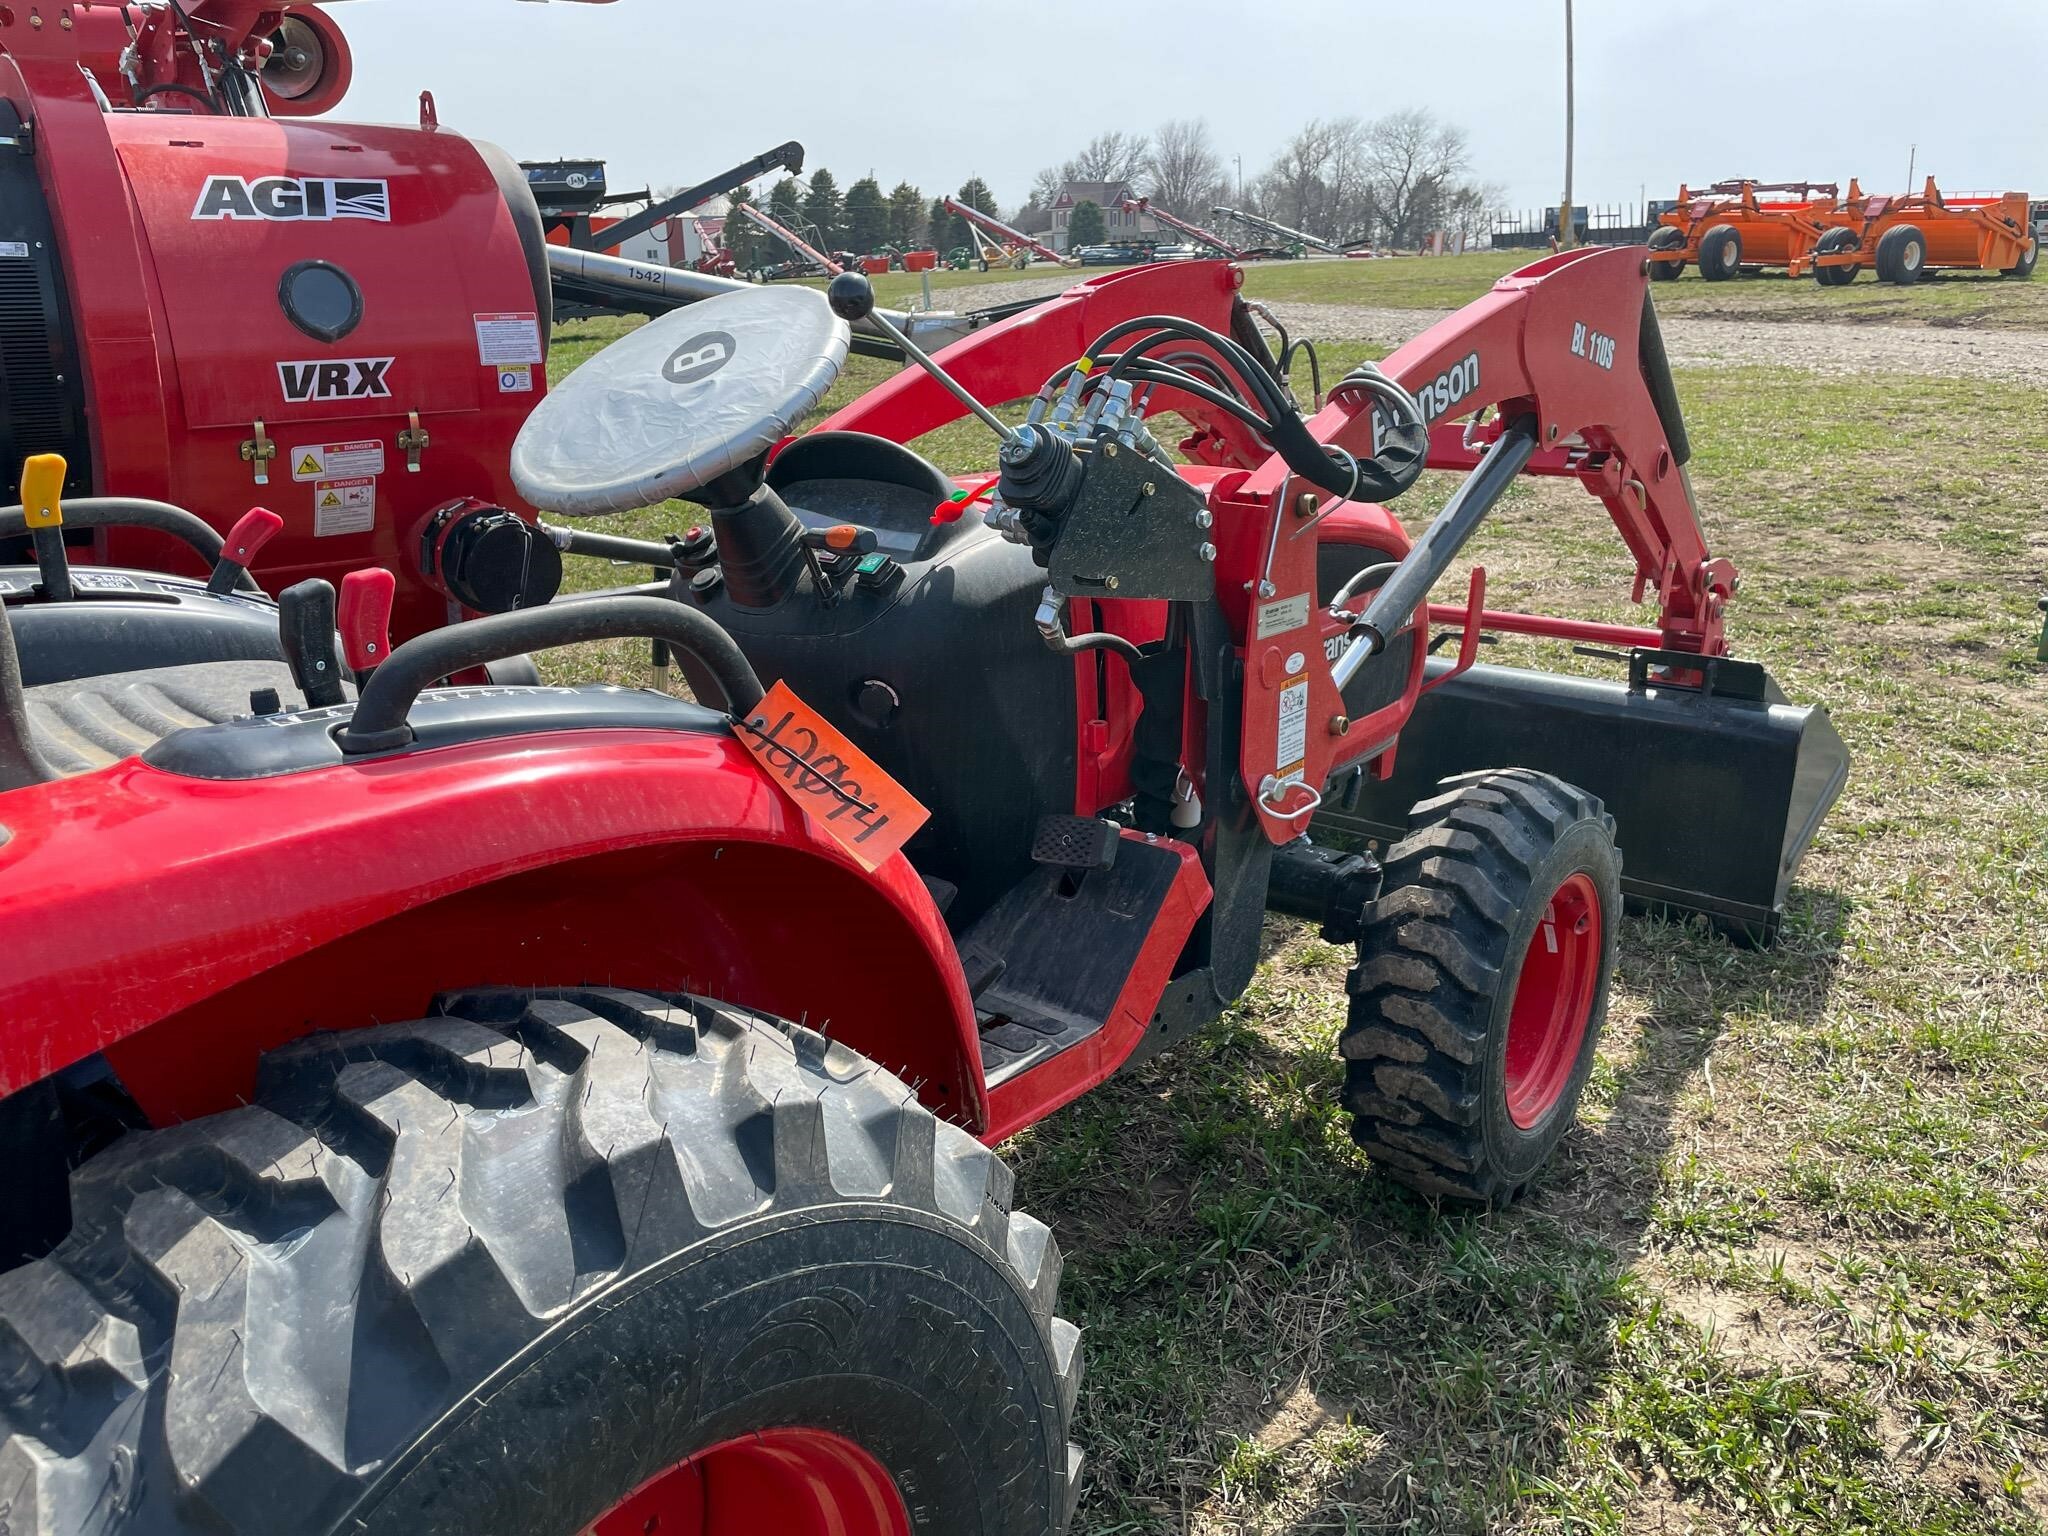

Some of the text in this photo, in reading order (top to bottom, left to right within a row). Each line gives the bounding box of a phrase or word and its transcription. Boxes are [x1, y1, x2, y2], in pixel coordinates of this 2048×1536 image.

[199, 179, 327, 217] AGI
[628, 267, 661, 283] 1542
[673, 342, 726, 373] B
[1571, 321, 1616, 370] BL 110S
[281, 361, 388, 398] VRX
[344, 443, 374, 451] DANGER
[334, 479, 368, 487] DANGER
[752, 711, 889, 843] 12094
